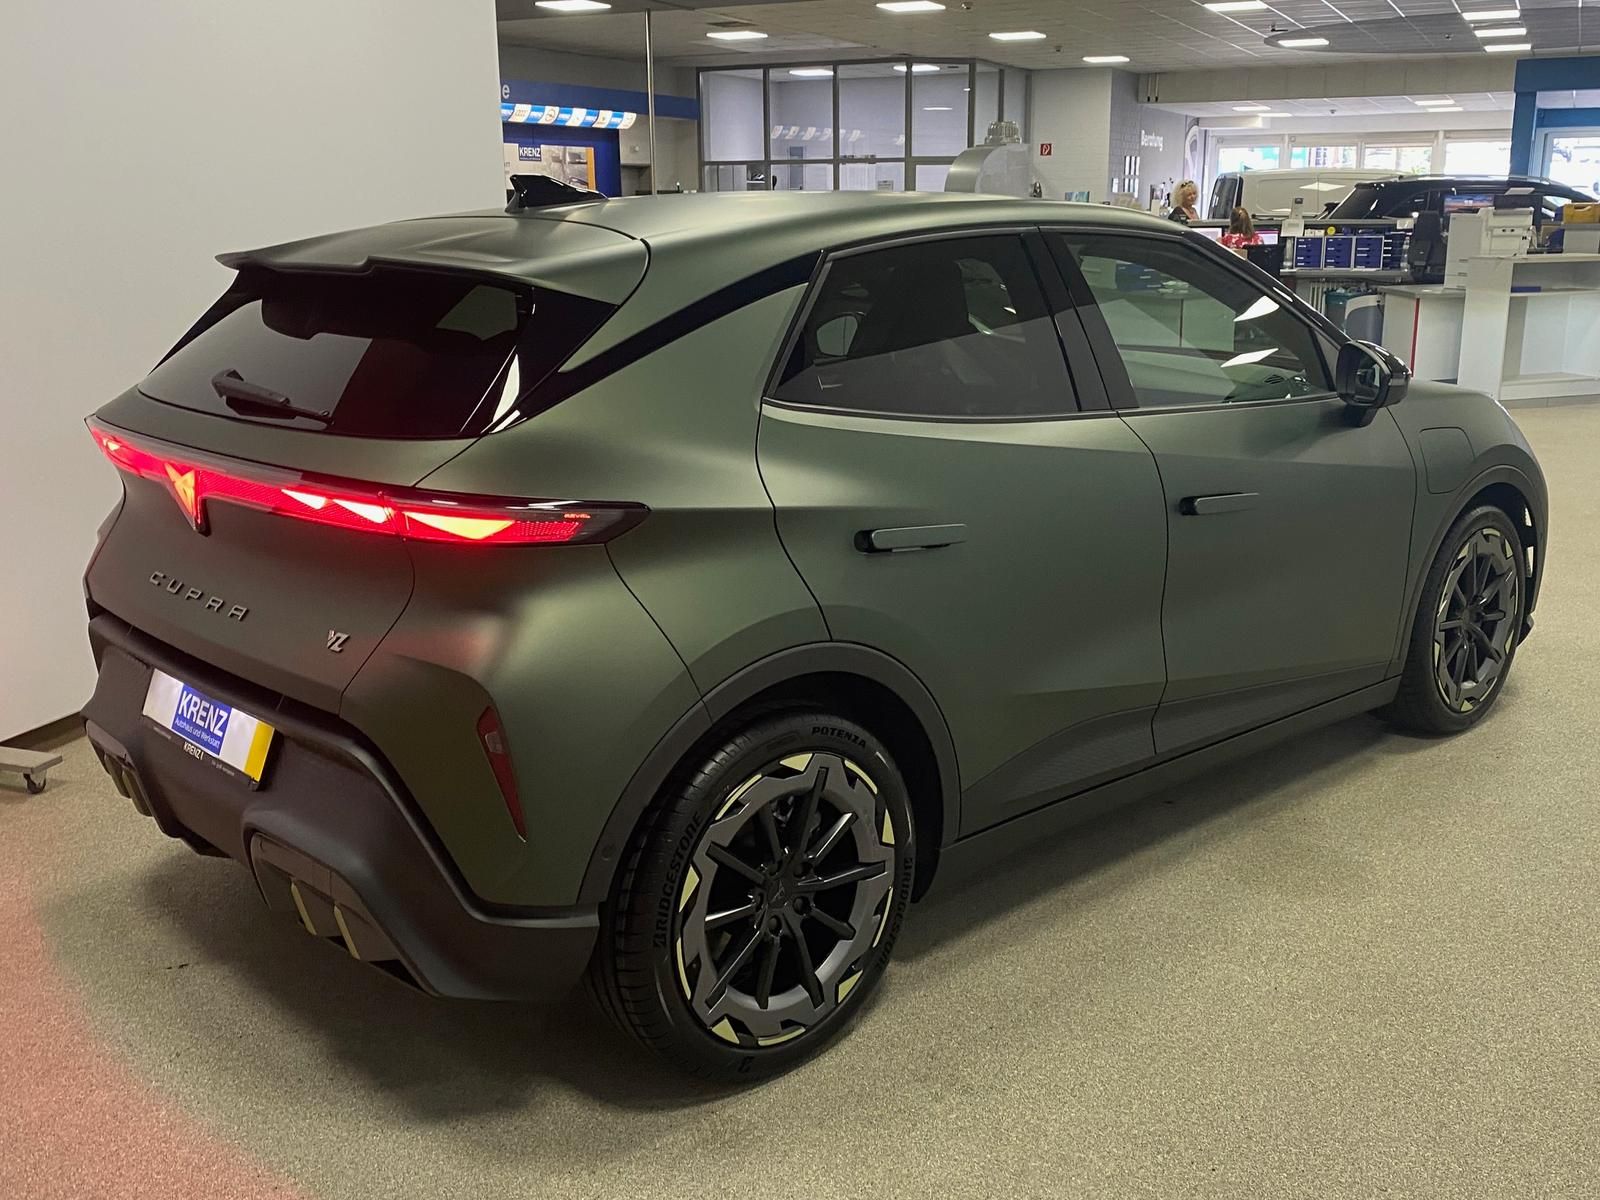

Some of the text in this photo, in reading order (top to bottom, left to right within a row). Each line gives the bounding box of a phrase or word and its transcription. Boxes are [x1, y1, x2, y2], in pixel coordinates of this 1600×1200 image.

[519, 146, 541, 157] KRENZ
[150, 571, 249, 621] CUPRA
[174, 717, 193, 734] Autohaus
[192, 727, 201, 738] und
[201, 731, 221, 749] Werkstatt
[178, 690, 228, 738] KRENZ
[811, 726, 866, 748] POTENZA
[653, 811, 702, 949] BRIDGESTONE
